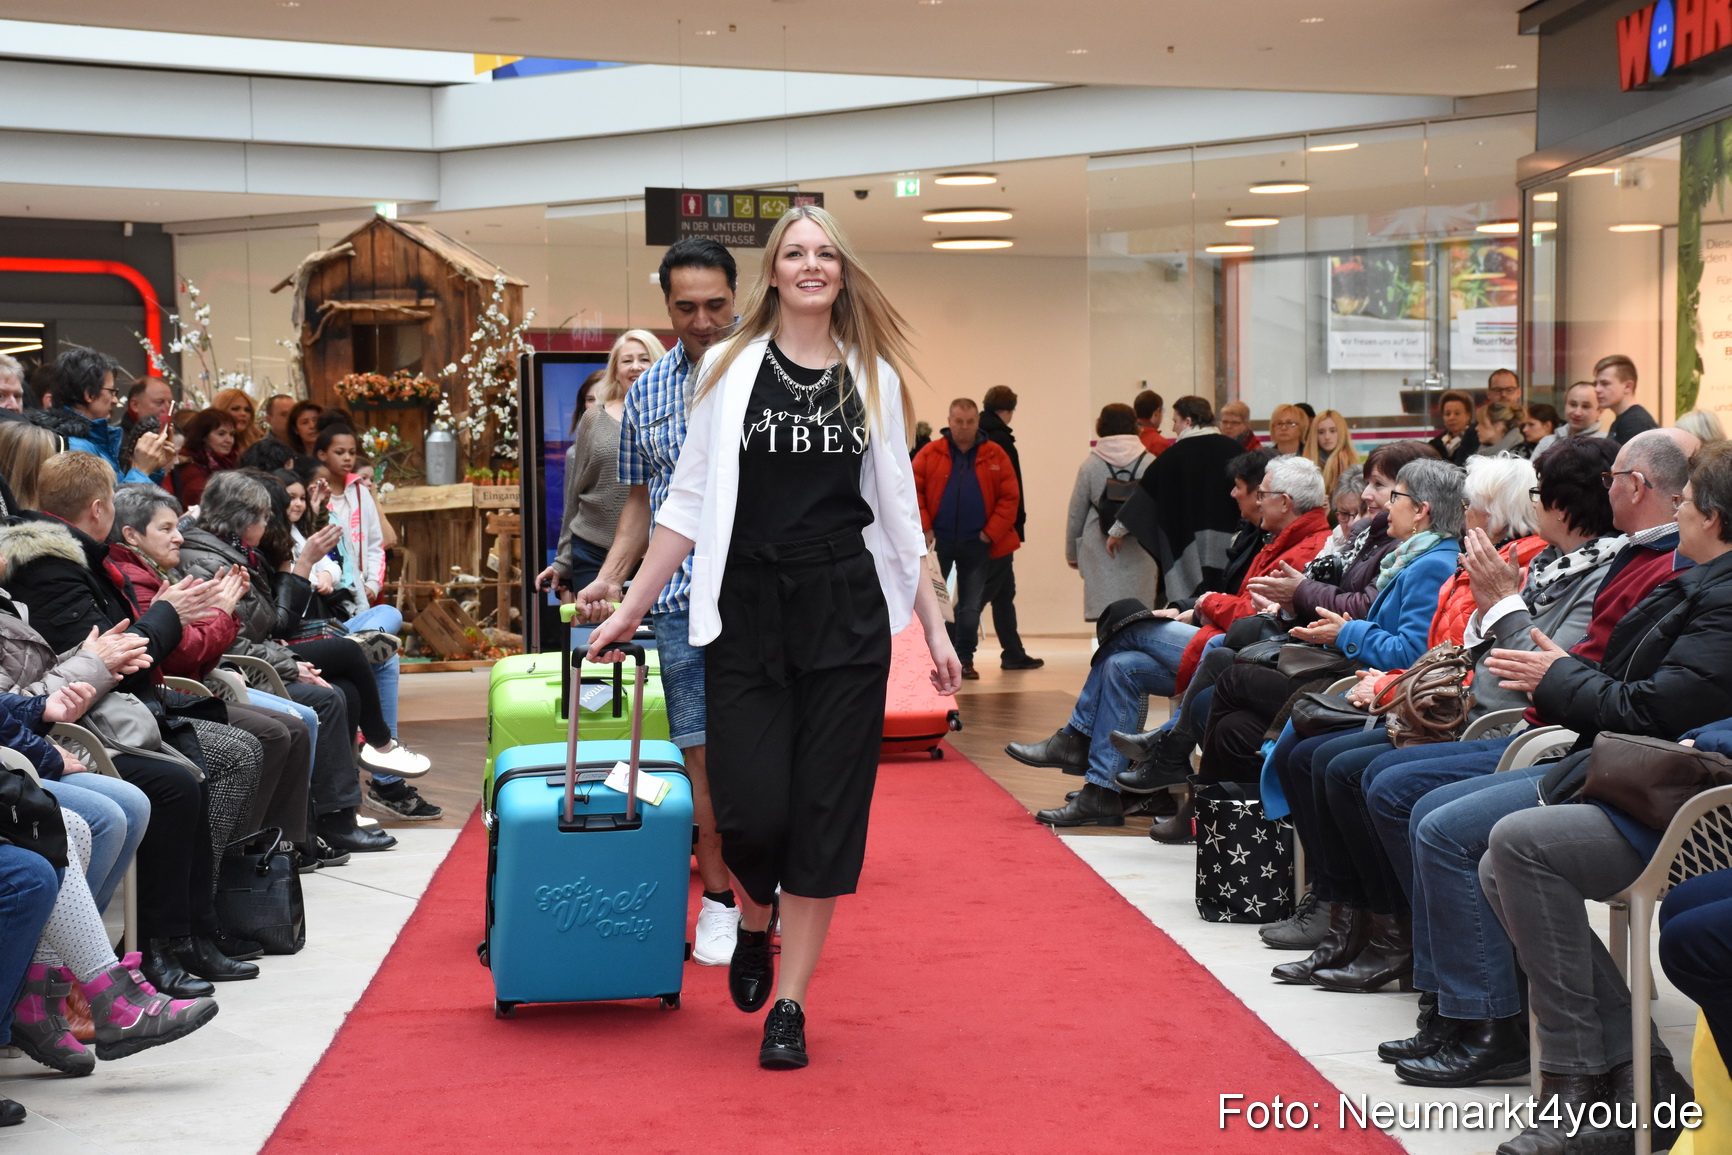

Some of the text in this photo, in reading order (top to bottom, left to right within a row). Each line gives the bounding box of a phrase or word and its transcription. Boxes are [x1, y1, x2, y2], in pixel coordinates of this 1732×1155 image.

[681, 221, 756, 232] IN DER UNTEREN
[757, 406, 833, 432] good
[741, 424, 866, 454] VIBES
[482, 491, 520, 502] Eingang
[581, 684, 606, 703] TITAN
[535, 876, 592, 911] Good
[552, 881, 658, 933] Vibes
[596, 916, 654, 941] Only
